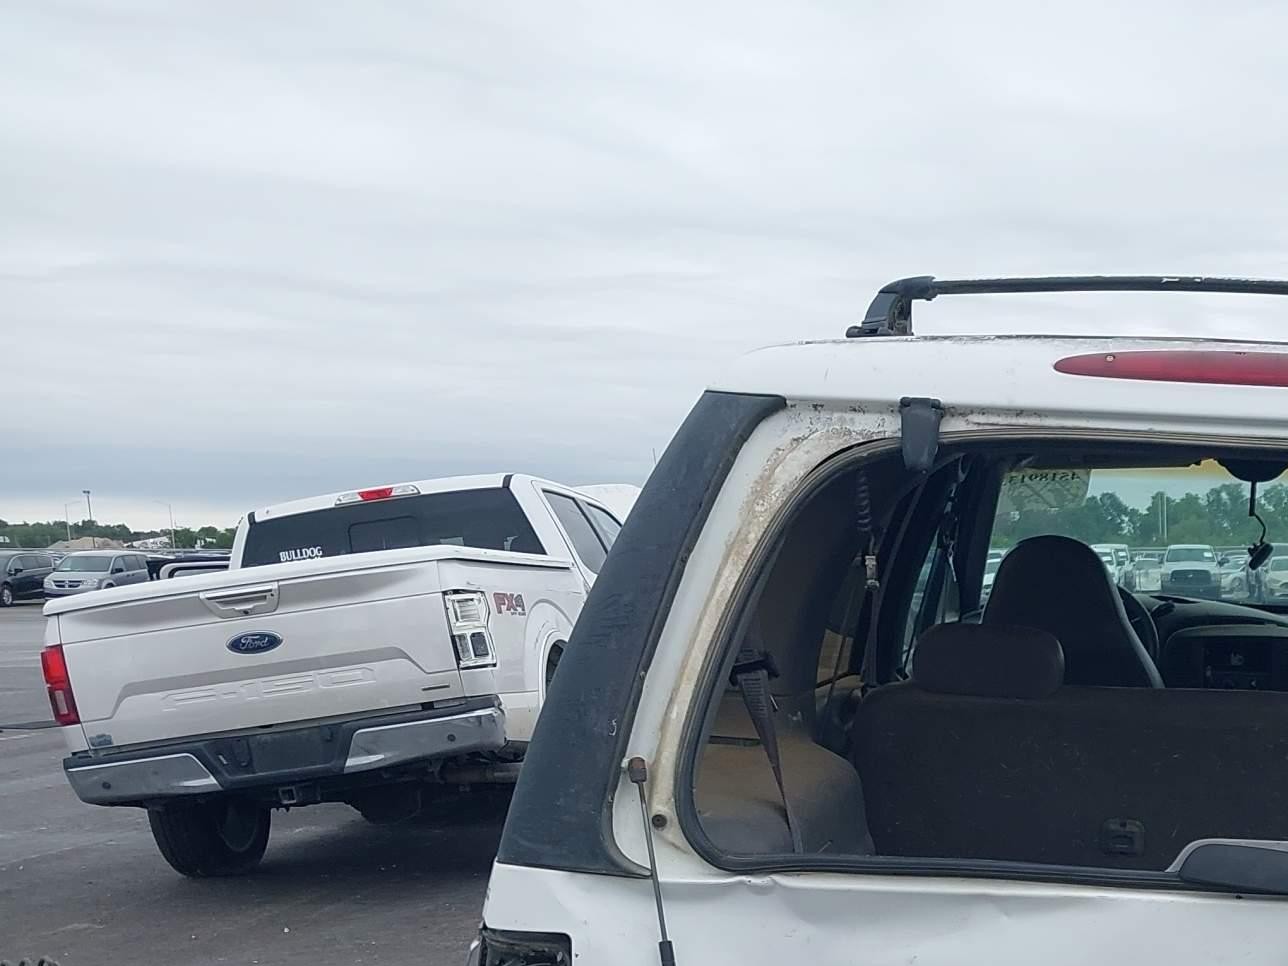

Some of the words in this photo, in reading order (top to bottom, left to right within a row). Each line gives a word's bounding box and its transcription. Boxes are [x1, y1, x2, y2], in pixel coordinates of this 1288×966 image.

[279, 546, 323, 562] BULLDOG
[493, 592, 526, 615] FX4
[240, 635, 270, 650] Ford
[161, 666, 377, 712] F-150
